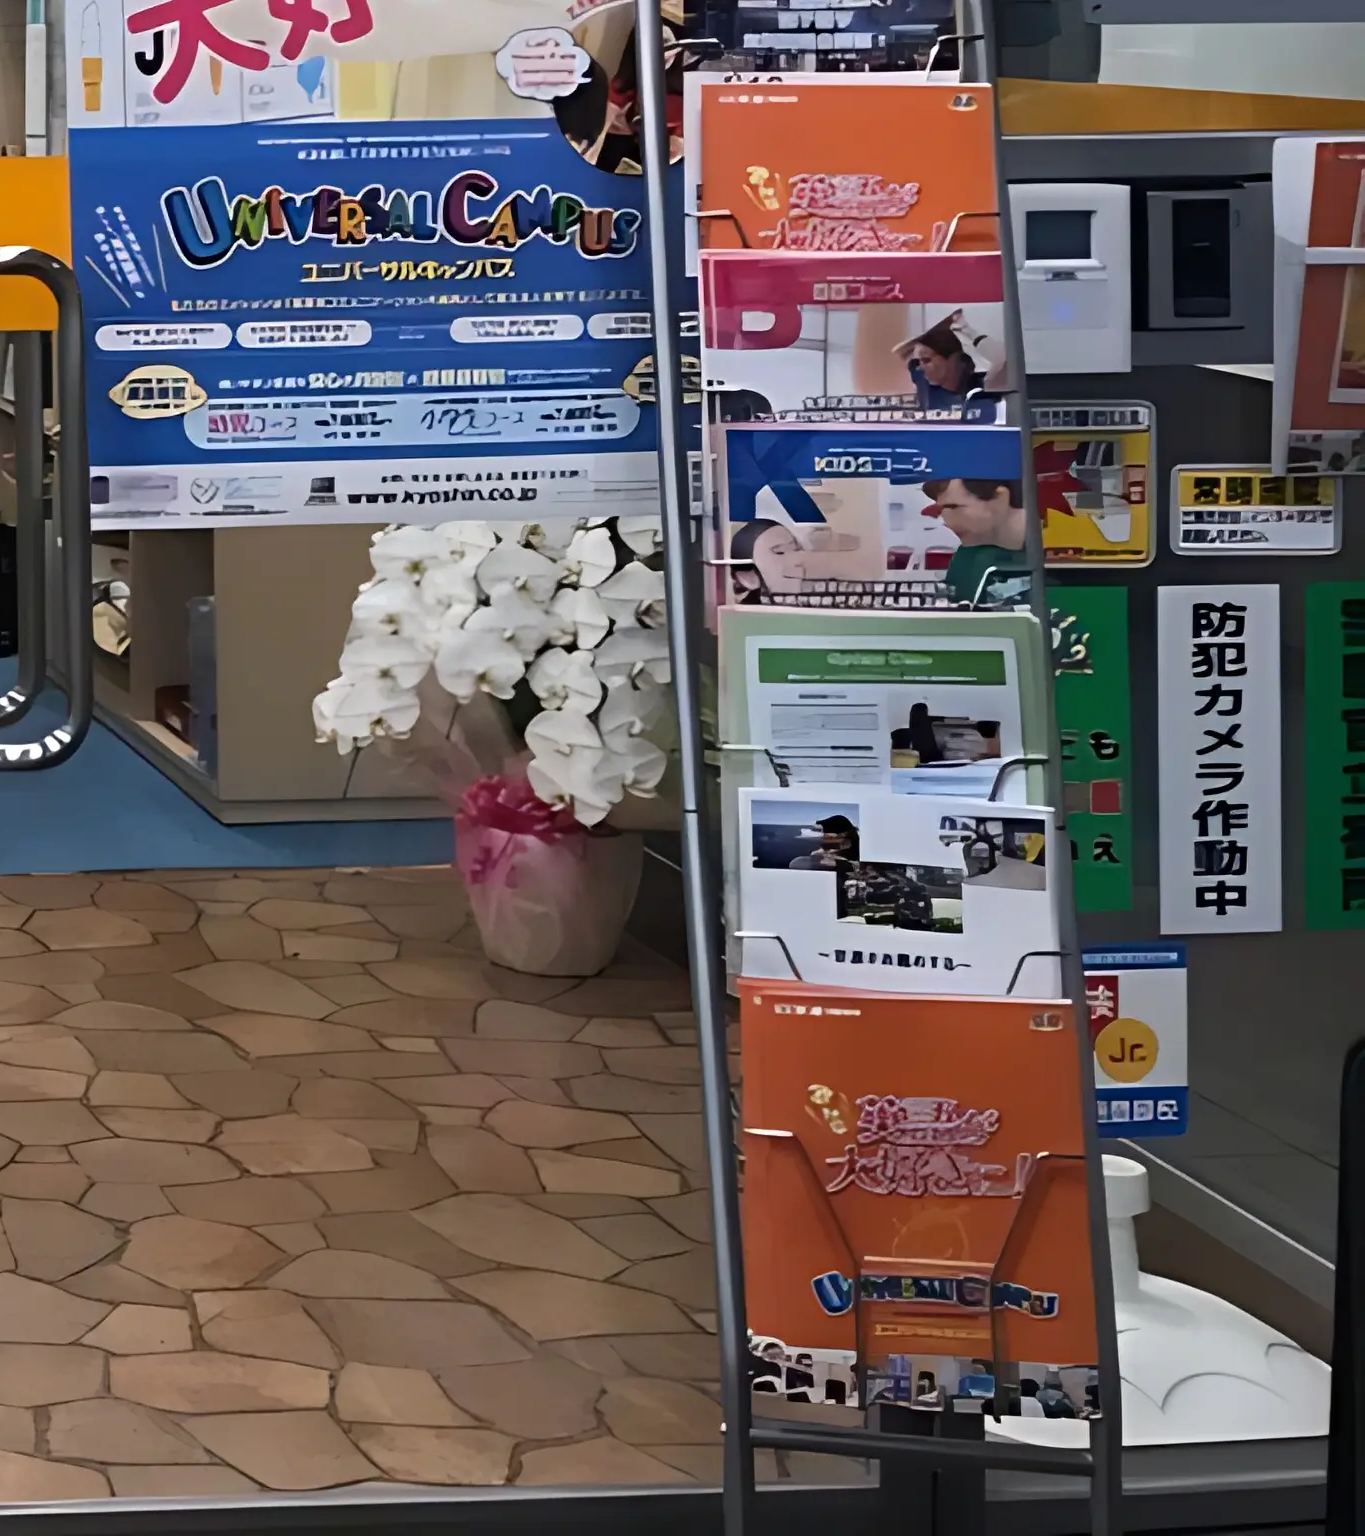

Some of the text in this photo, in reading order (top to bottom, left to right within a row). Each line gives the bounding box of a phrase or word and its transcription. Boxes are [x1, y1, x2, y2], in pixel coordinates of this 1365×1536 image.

[159, 169, 642, 270] UNIVERSAL CAMPUS
[1191, 601, 1249, 917] 防犯カメラ作動中
